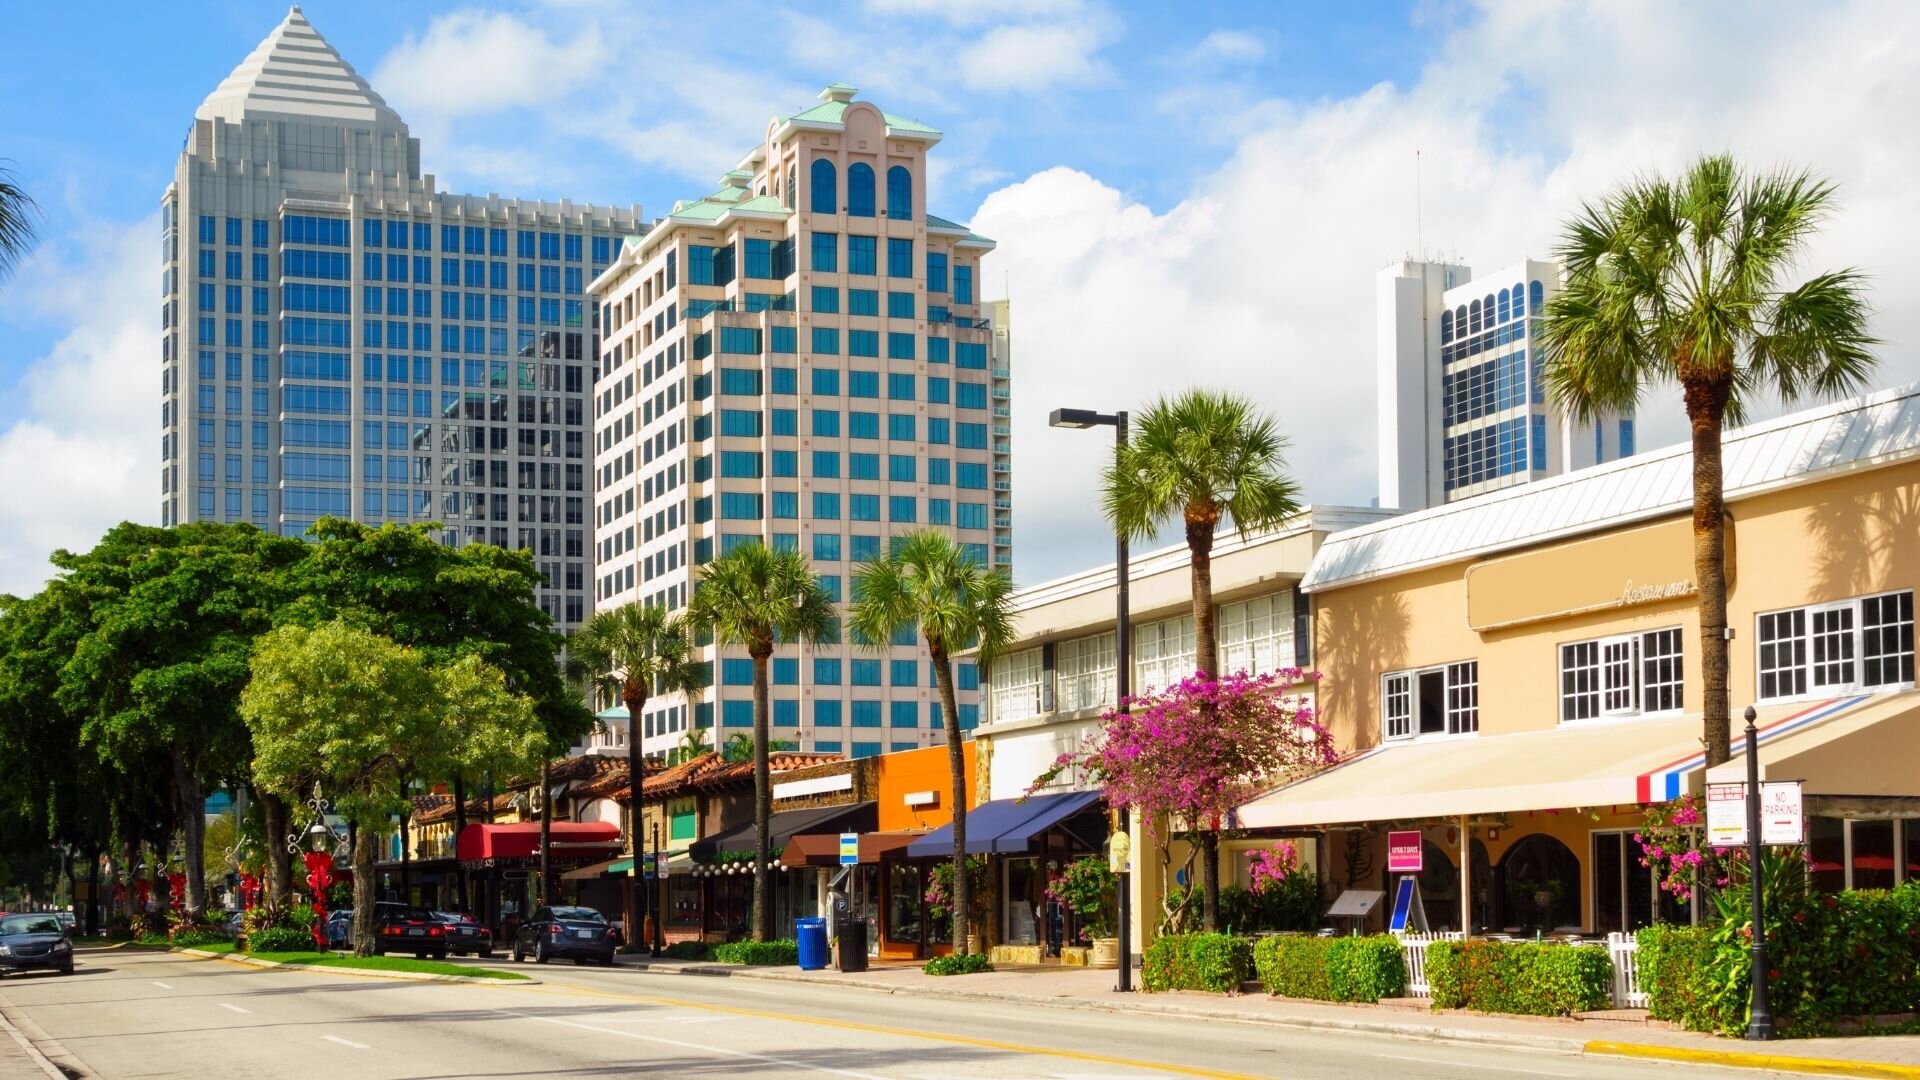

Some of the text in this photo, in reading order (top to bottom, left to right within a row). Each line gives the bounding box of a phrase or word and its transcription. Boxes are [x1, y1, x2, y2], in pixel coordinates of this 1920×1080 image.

[1618, 579, 1690, 607] Restaurant
[1775, 792, 1787, 803] NO
[1765, 804, 1798, 816] PARKING
